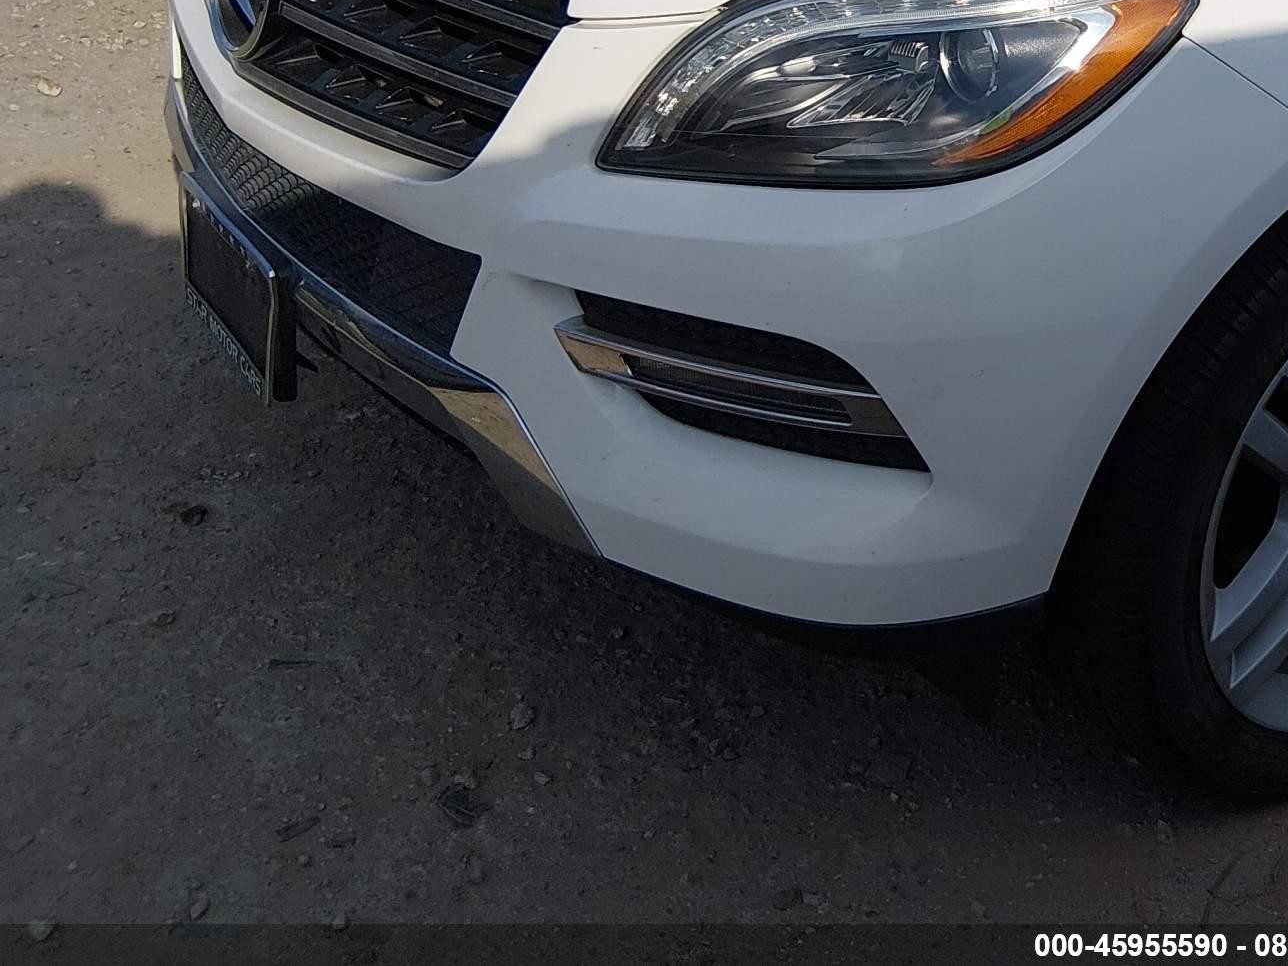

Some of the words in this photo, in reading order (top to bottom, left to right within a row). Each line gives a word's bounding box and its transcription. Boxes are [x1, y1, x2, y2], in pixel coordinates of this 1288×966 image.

[186, 287, 208, 322] STAR
[209, 314, 239, 363] MOTOR
[240, 355, 262, 396] CARS
